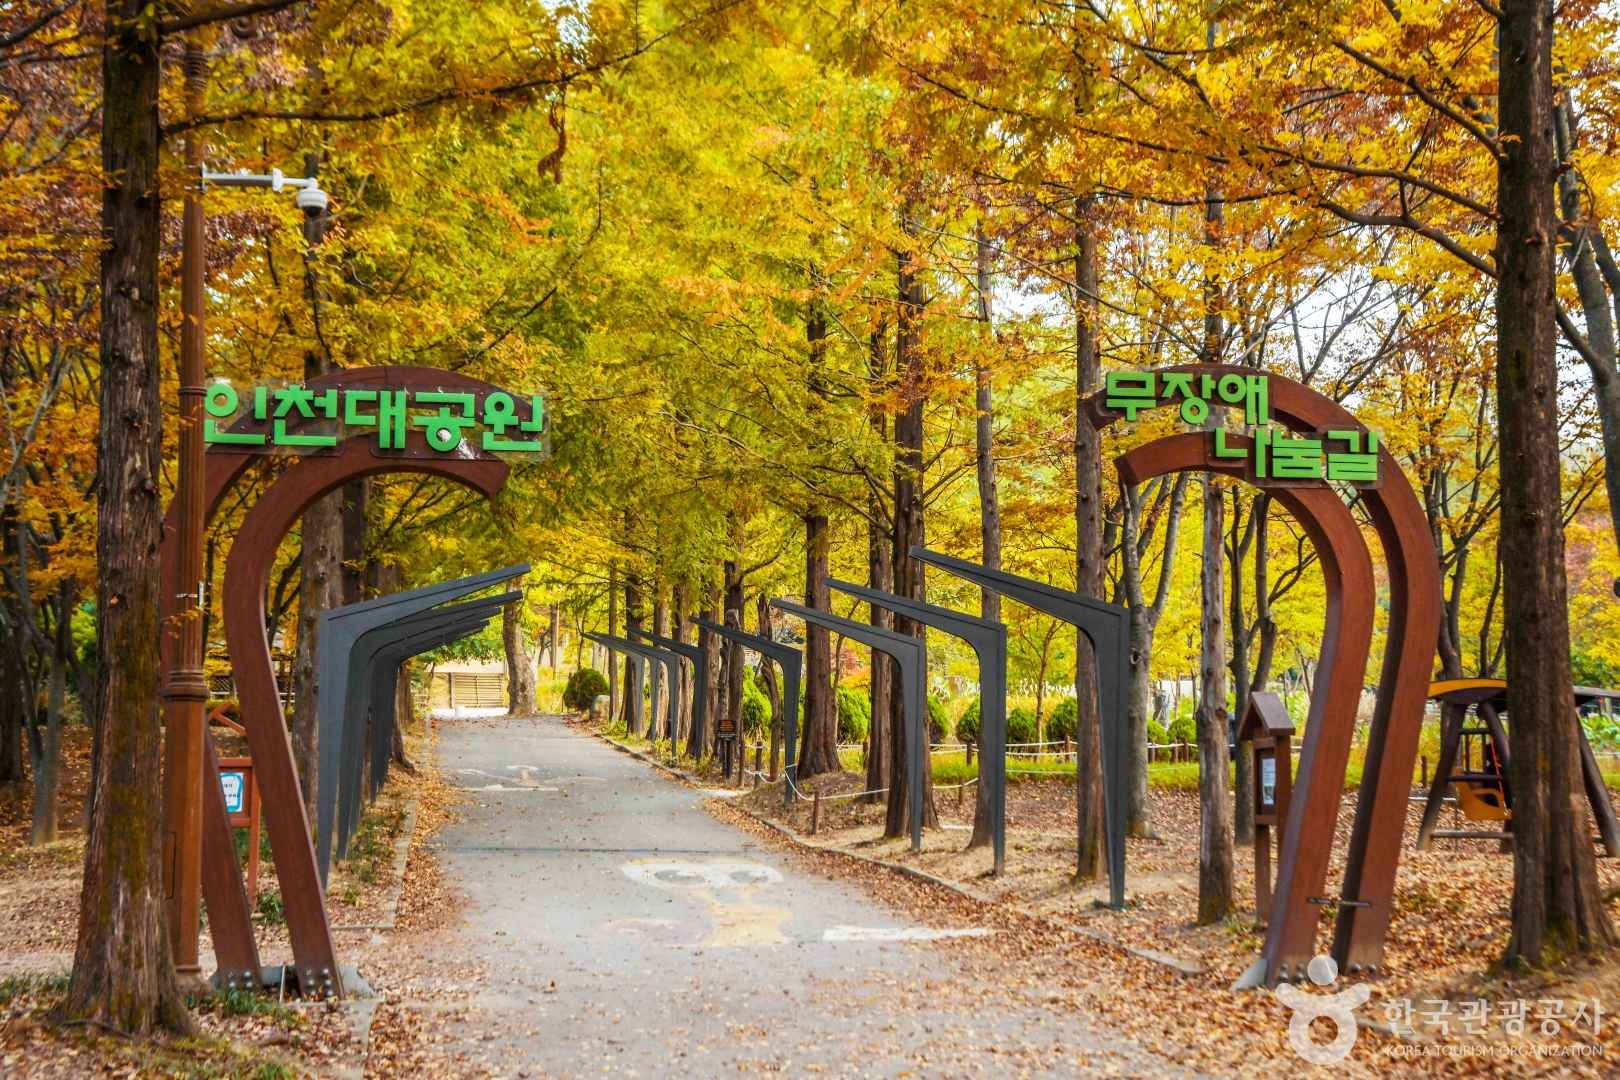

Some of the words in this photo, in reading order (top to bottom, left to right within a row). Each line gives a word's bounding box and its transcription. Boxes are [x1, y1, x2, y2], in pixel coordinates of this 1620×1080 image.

[204, 383, 544, 451] 인천대공원
[1106, 371, 1269, 425] 무장애
[1215, 427, 1379, 480] 나눔길
